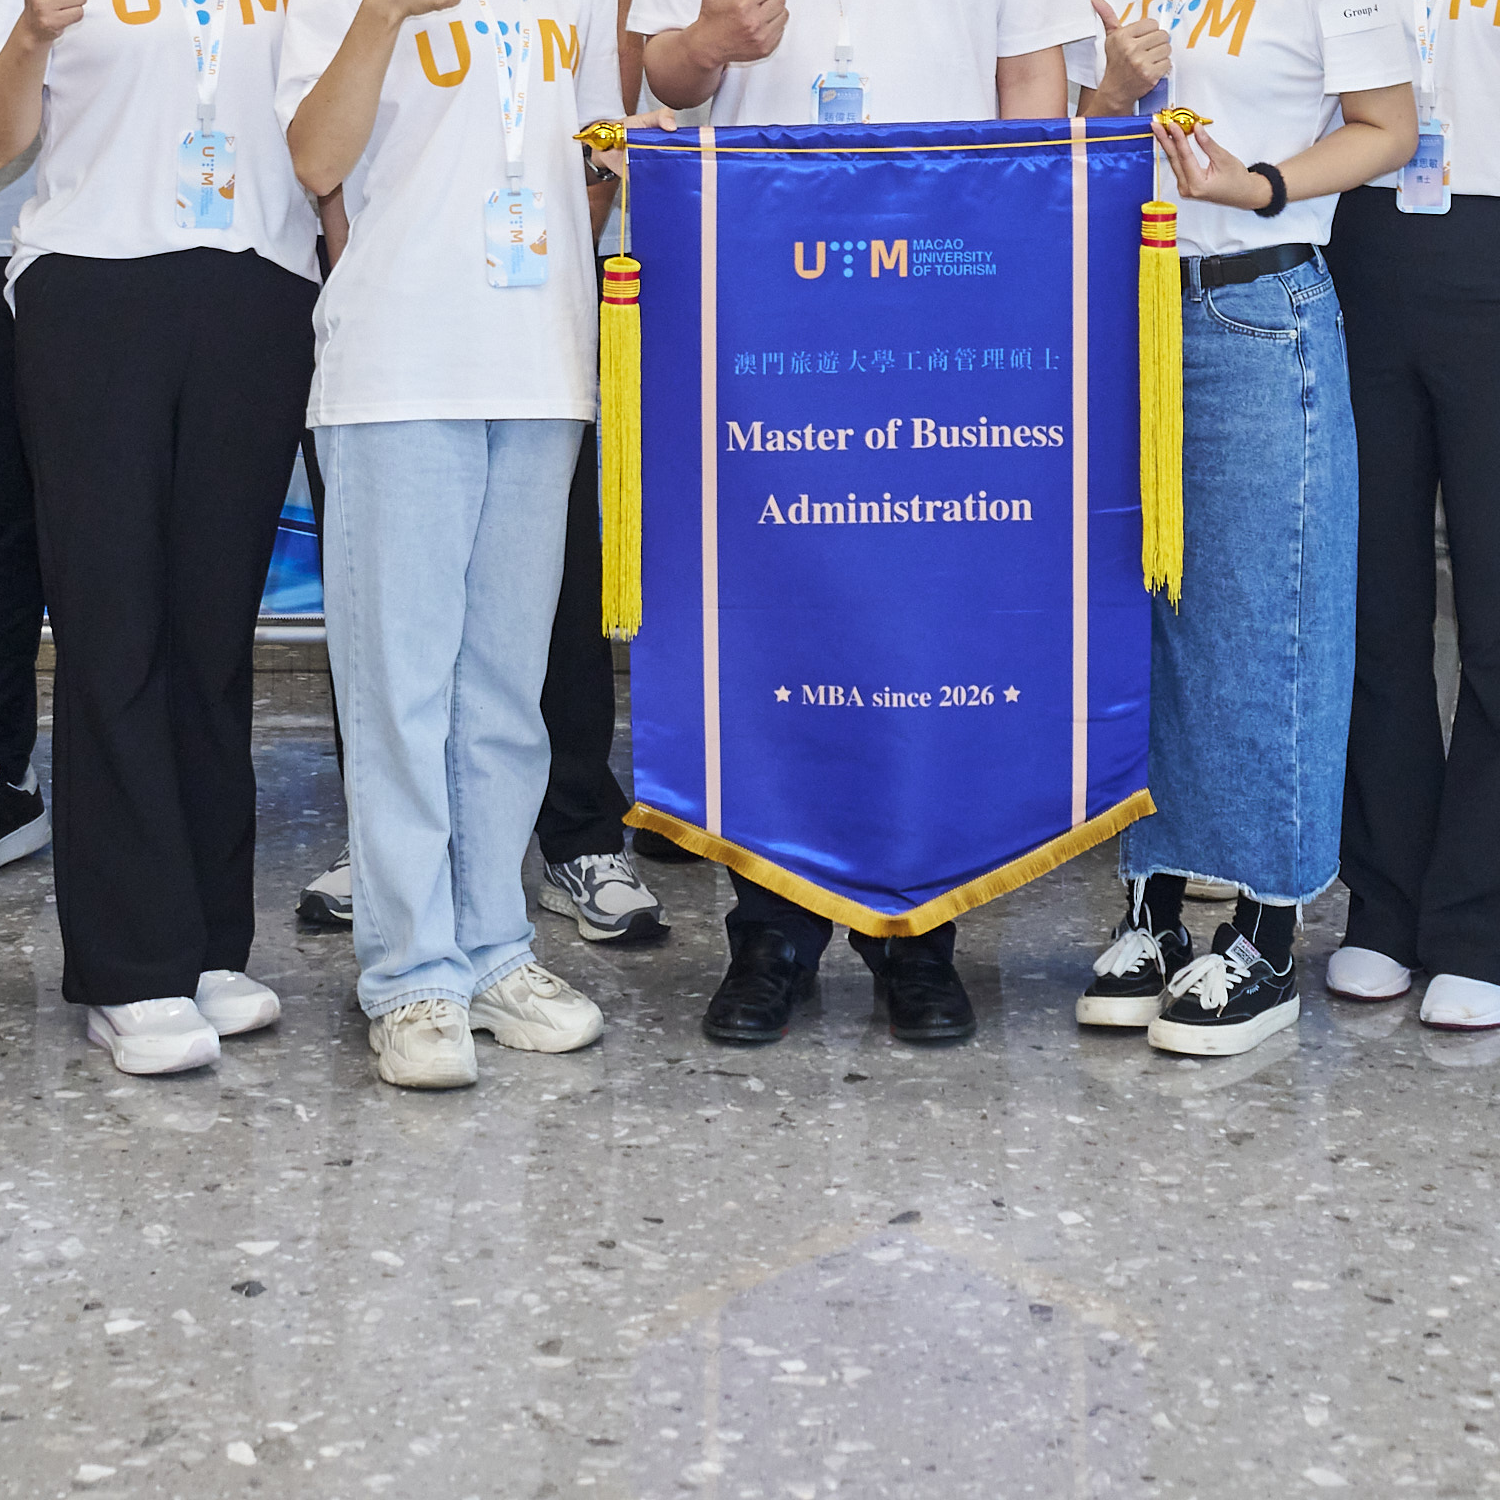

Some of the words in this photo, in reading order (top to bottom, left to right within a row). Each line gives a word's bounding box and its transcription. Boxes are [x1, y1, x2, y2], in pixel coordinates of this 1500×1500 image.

[1343, 7, 1373, 18] Group
[913, 239, 964, 251] MACAO
[795, 239, 907, 279] UTM
[913, 252, 994, 264] UNIVERSITY
[913, 265, 931, 277] OF
[935, 264, 997, 277] TOURISM
[735, 348, 1059, 375] 澳門旅遊大學工商管理碩士
[726, 421, 854, 451] Master
[865, 418, 902, 449] of
[911, 417, 1063, 448] Business
[758, 491, 1032, 524] Administration
[802, 685, 864, 706] MBA
[873, 687, 931, 707] since
[939, 685, 994, 706] 2026
